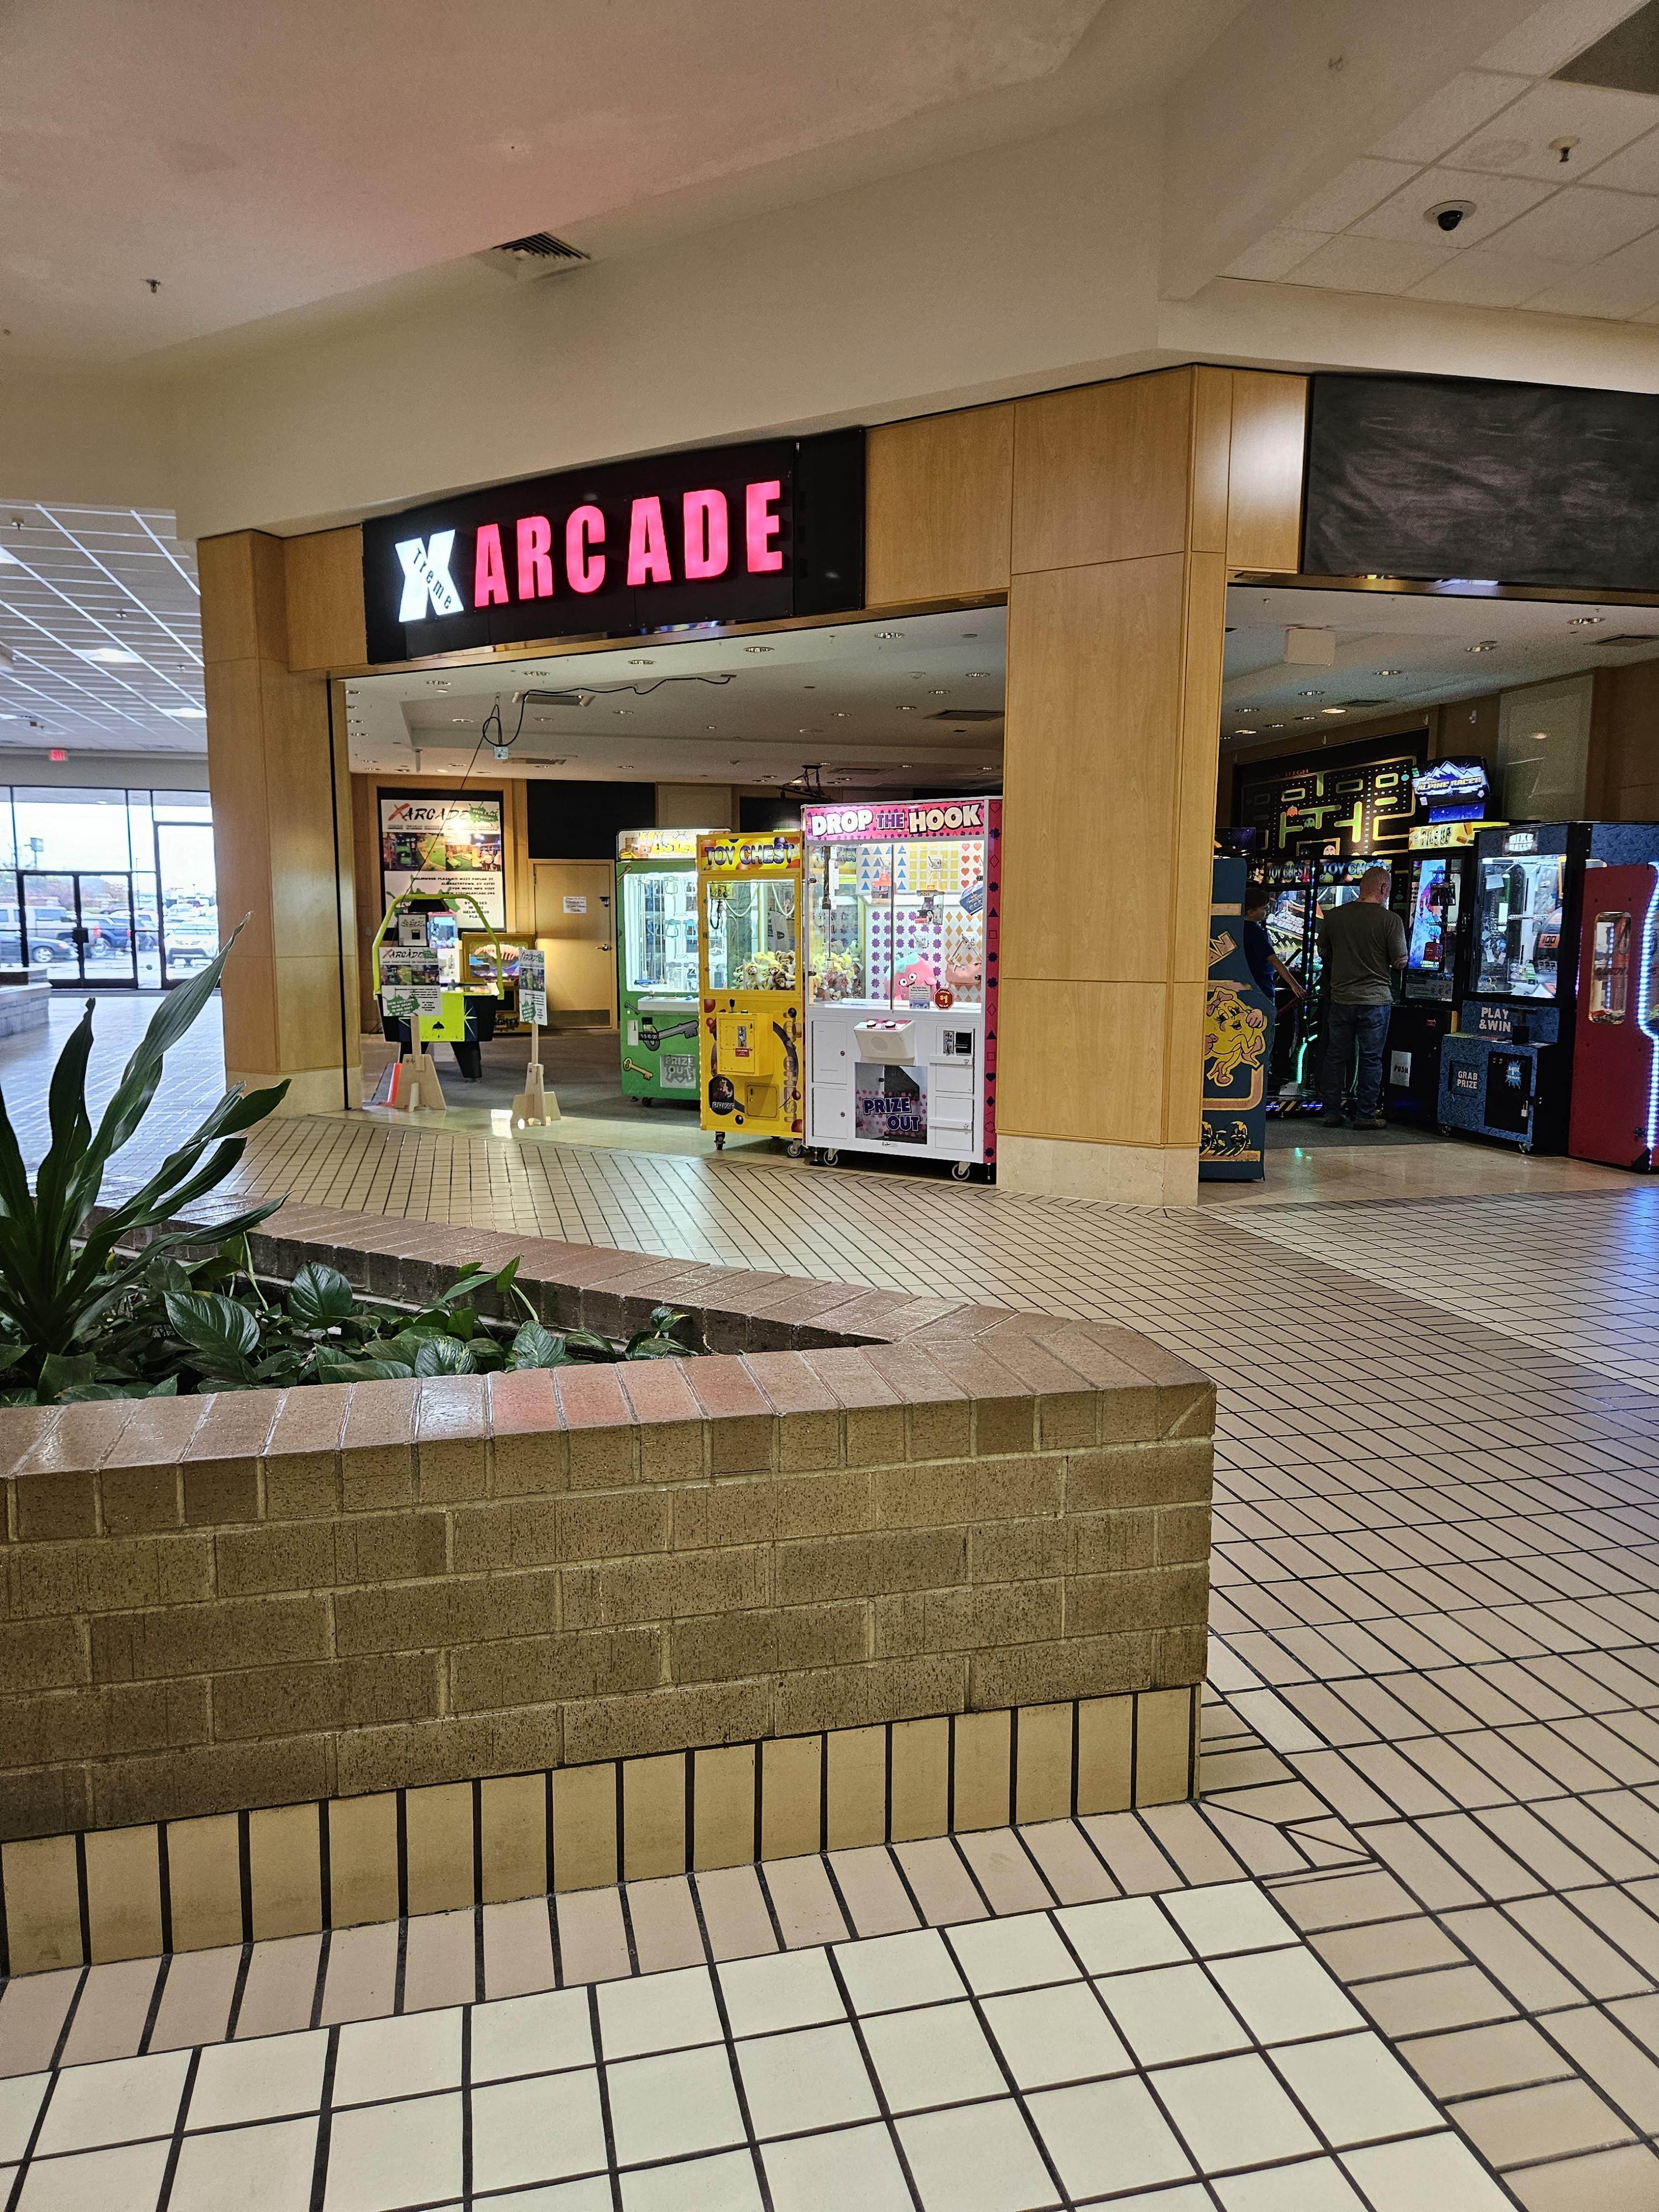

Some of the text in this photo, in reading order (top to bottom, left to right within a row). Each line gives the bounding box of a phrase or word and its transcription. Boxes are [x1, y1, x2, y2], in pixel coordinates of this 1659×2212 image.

[474, 480, 782, 608] ARCADE
[1417, 781, 1449, 792] ALPINE
[1450, 776, 1482, 787] RACER
[811, 803, 983, 837] DROP THE HOOK
[705, 843, 795, 866] TOY CHEST
[1268, 864, 1310, 879] TOY CHEST
[1322, 861, 1346, 875] TOY
[940, 995, 948, 1004] $1
[1481, 1006, 1509, 1020] PLAY
[1479, 1020, 1511, 1032] &WIN
[666, 1056, 695, 1066] PRIZE
[1393, 1065, 1408, 1074] PUSH
[1458, 1071, 1478, 1080] GRAB
[1457, 1079, 1478, 1089] PRIZE
[712, 1101, 734, 1109] PRIZE
[863, 1097, 912, 1115] PRIZE
[886, 1114, 921, 1131] OUT
